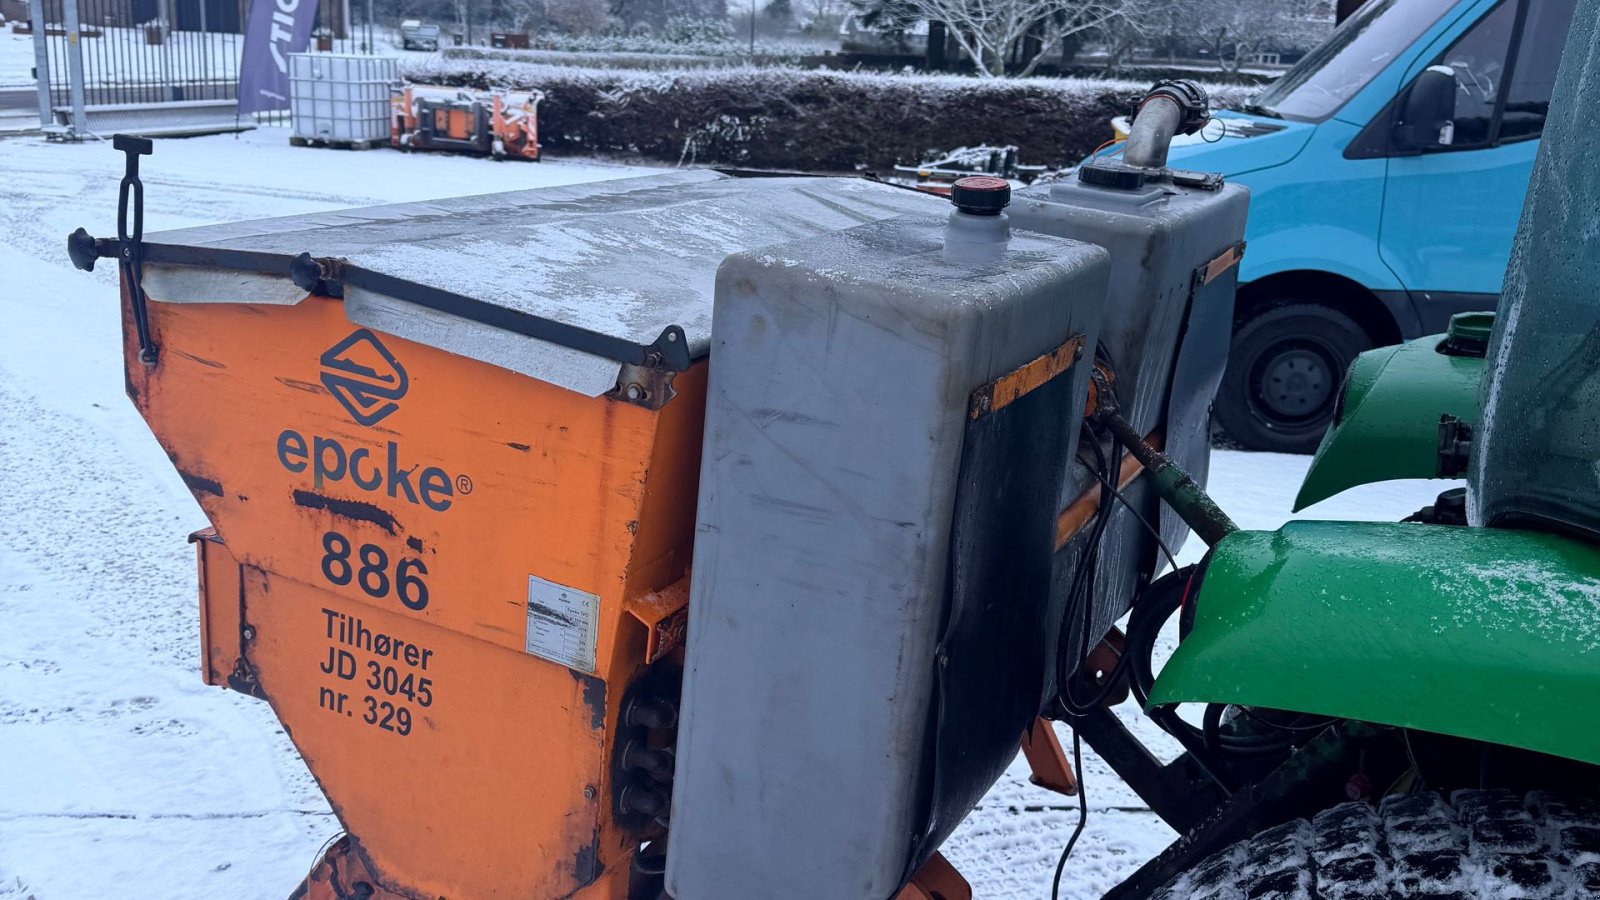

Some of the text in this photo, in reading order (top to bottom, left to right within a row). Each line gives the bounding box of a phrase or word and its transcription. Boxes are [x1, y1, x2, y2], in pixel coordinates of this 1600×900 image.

[321, 531, 429, 610] 886
[322, 607, 433, 670] Tilhører
[320, 646, 432, 707] JD 3045
[320, 686, 412, 736] nr. 329
